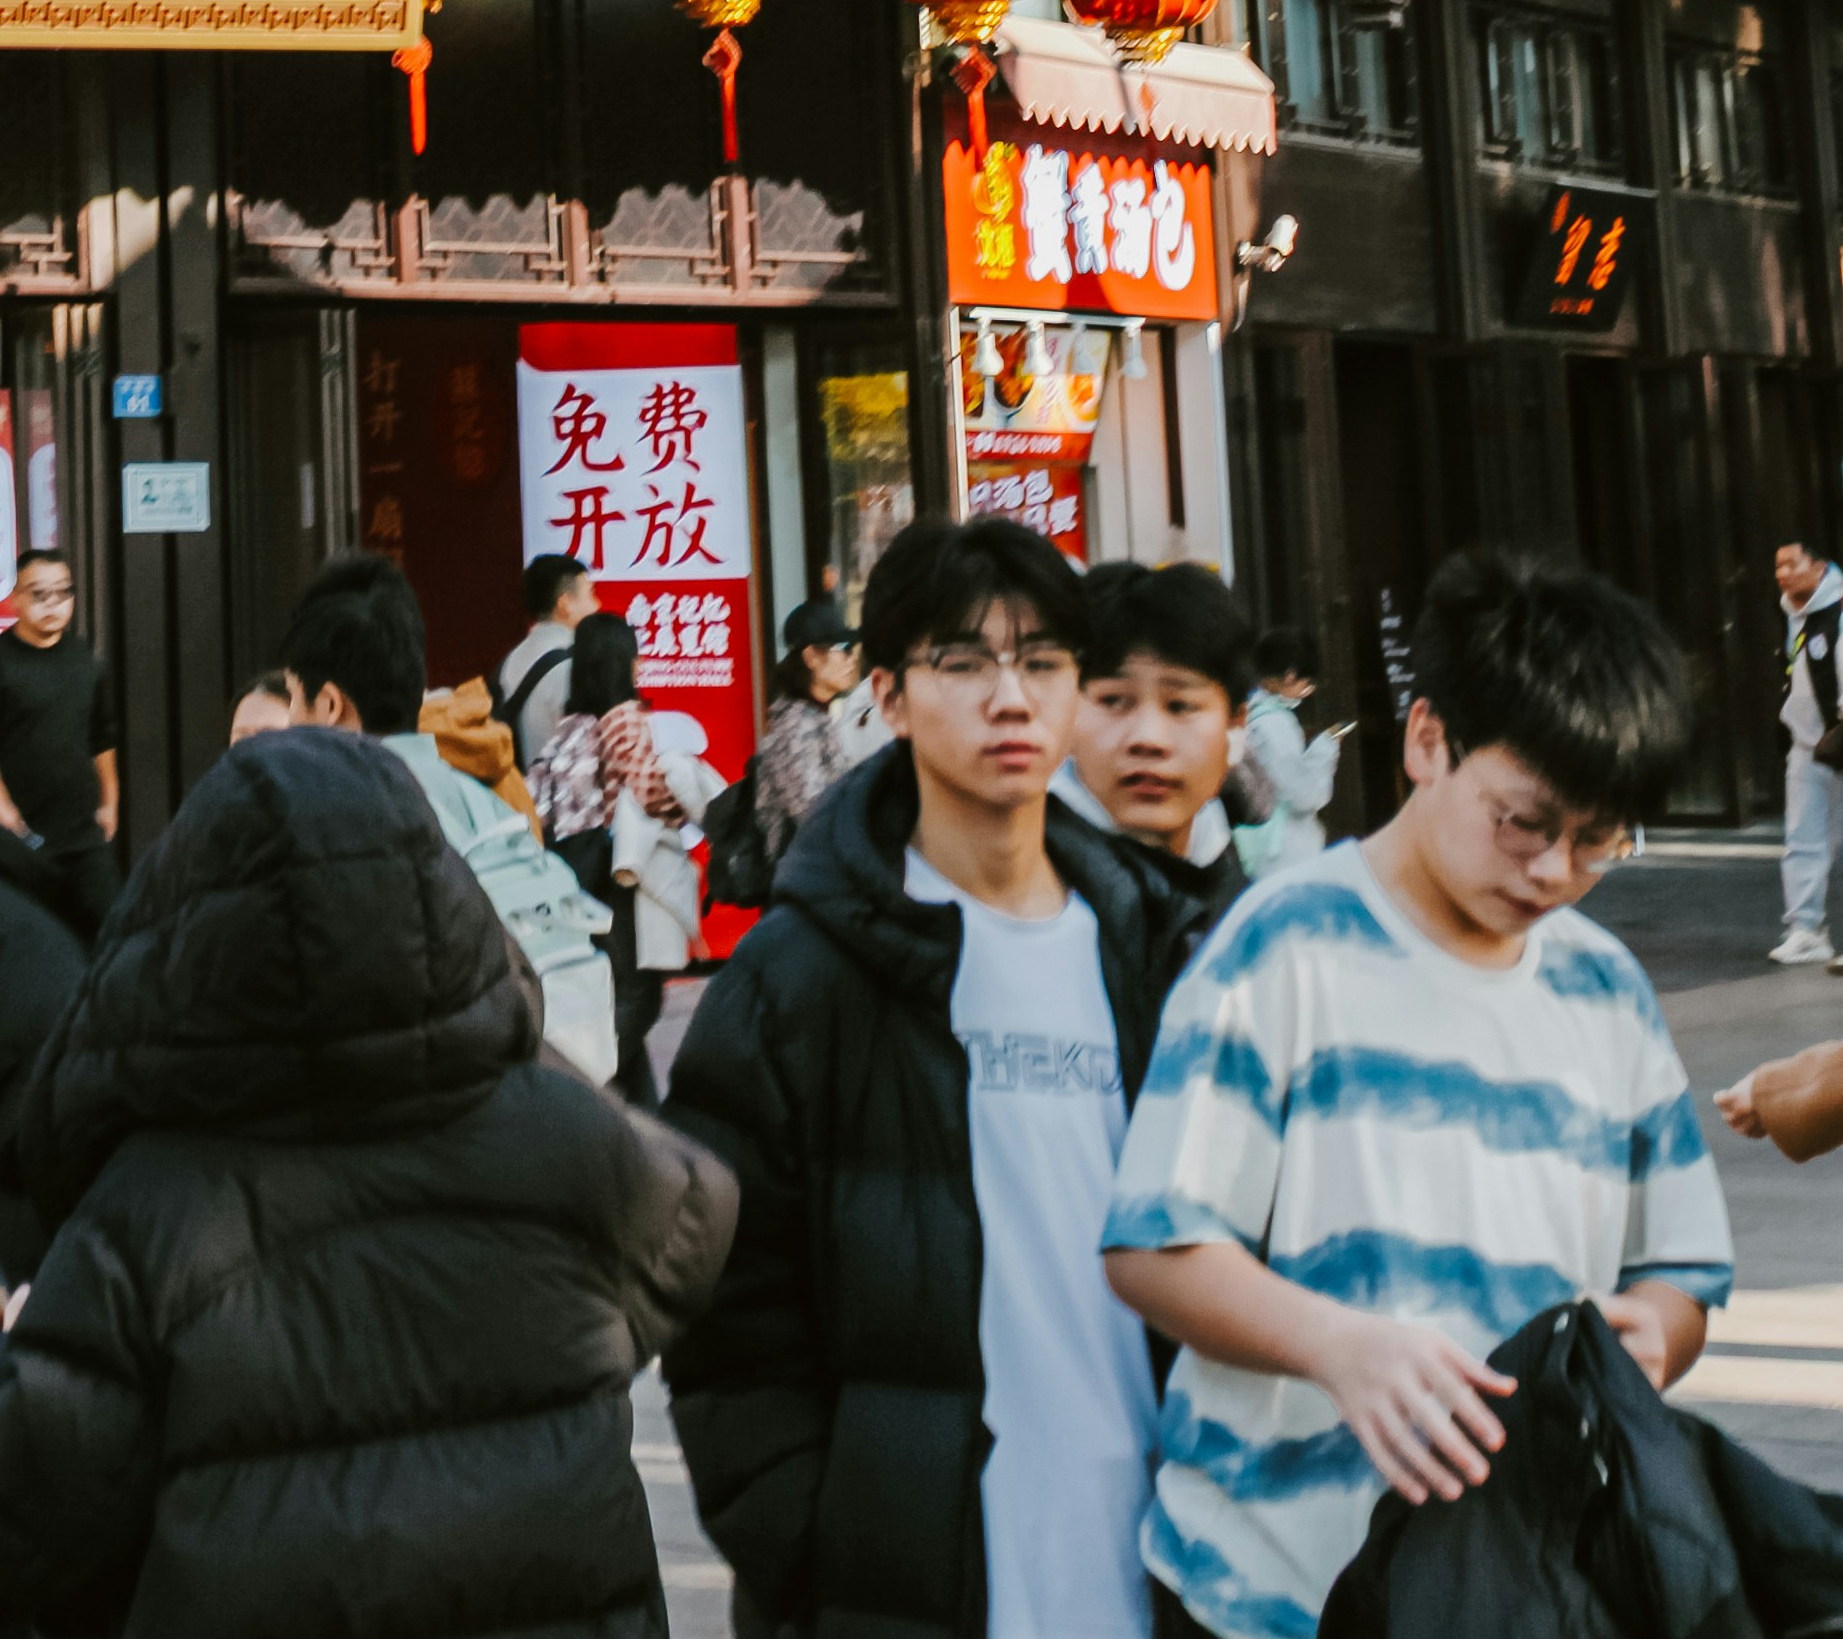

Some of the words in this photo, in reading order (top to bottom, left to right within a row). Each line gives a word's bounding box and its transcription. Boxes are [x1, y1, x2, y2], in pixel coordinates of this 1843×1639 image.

[364, 350, 404, 569] 打开一扇
[540, 381, 708, 477] 免费
[548, 482, 727, 569] 开放
